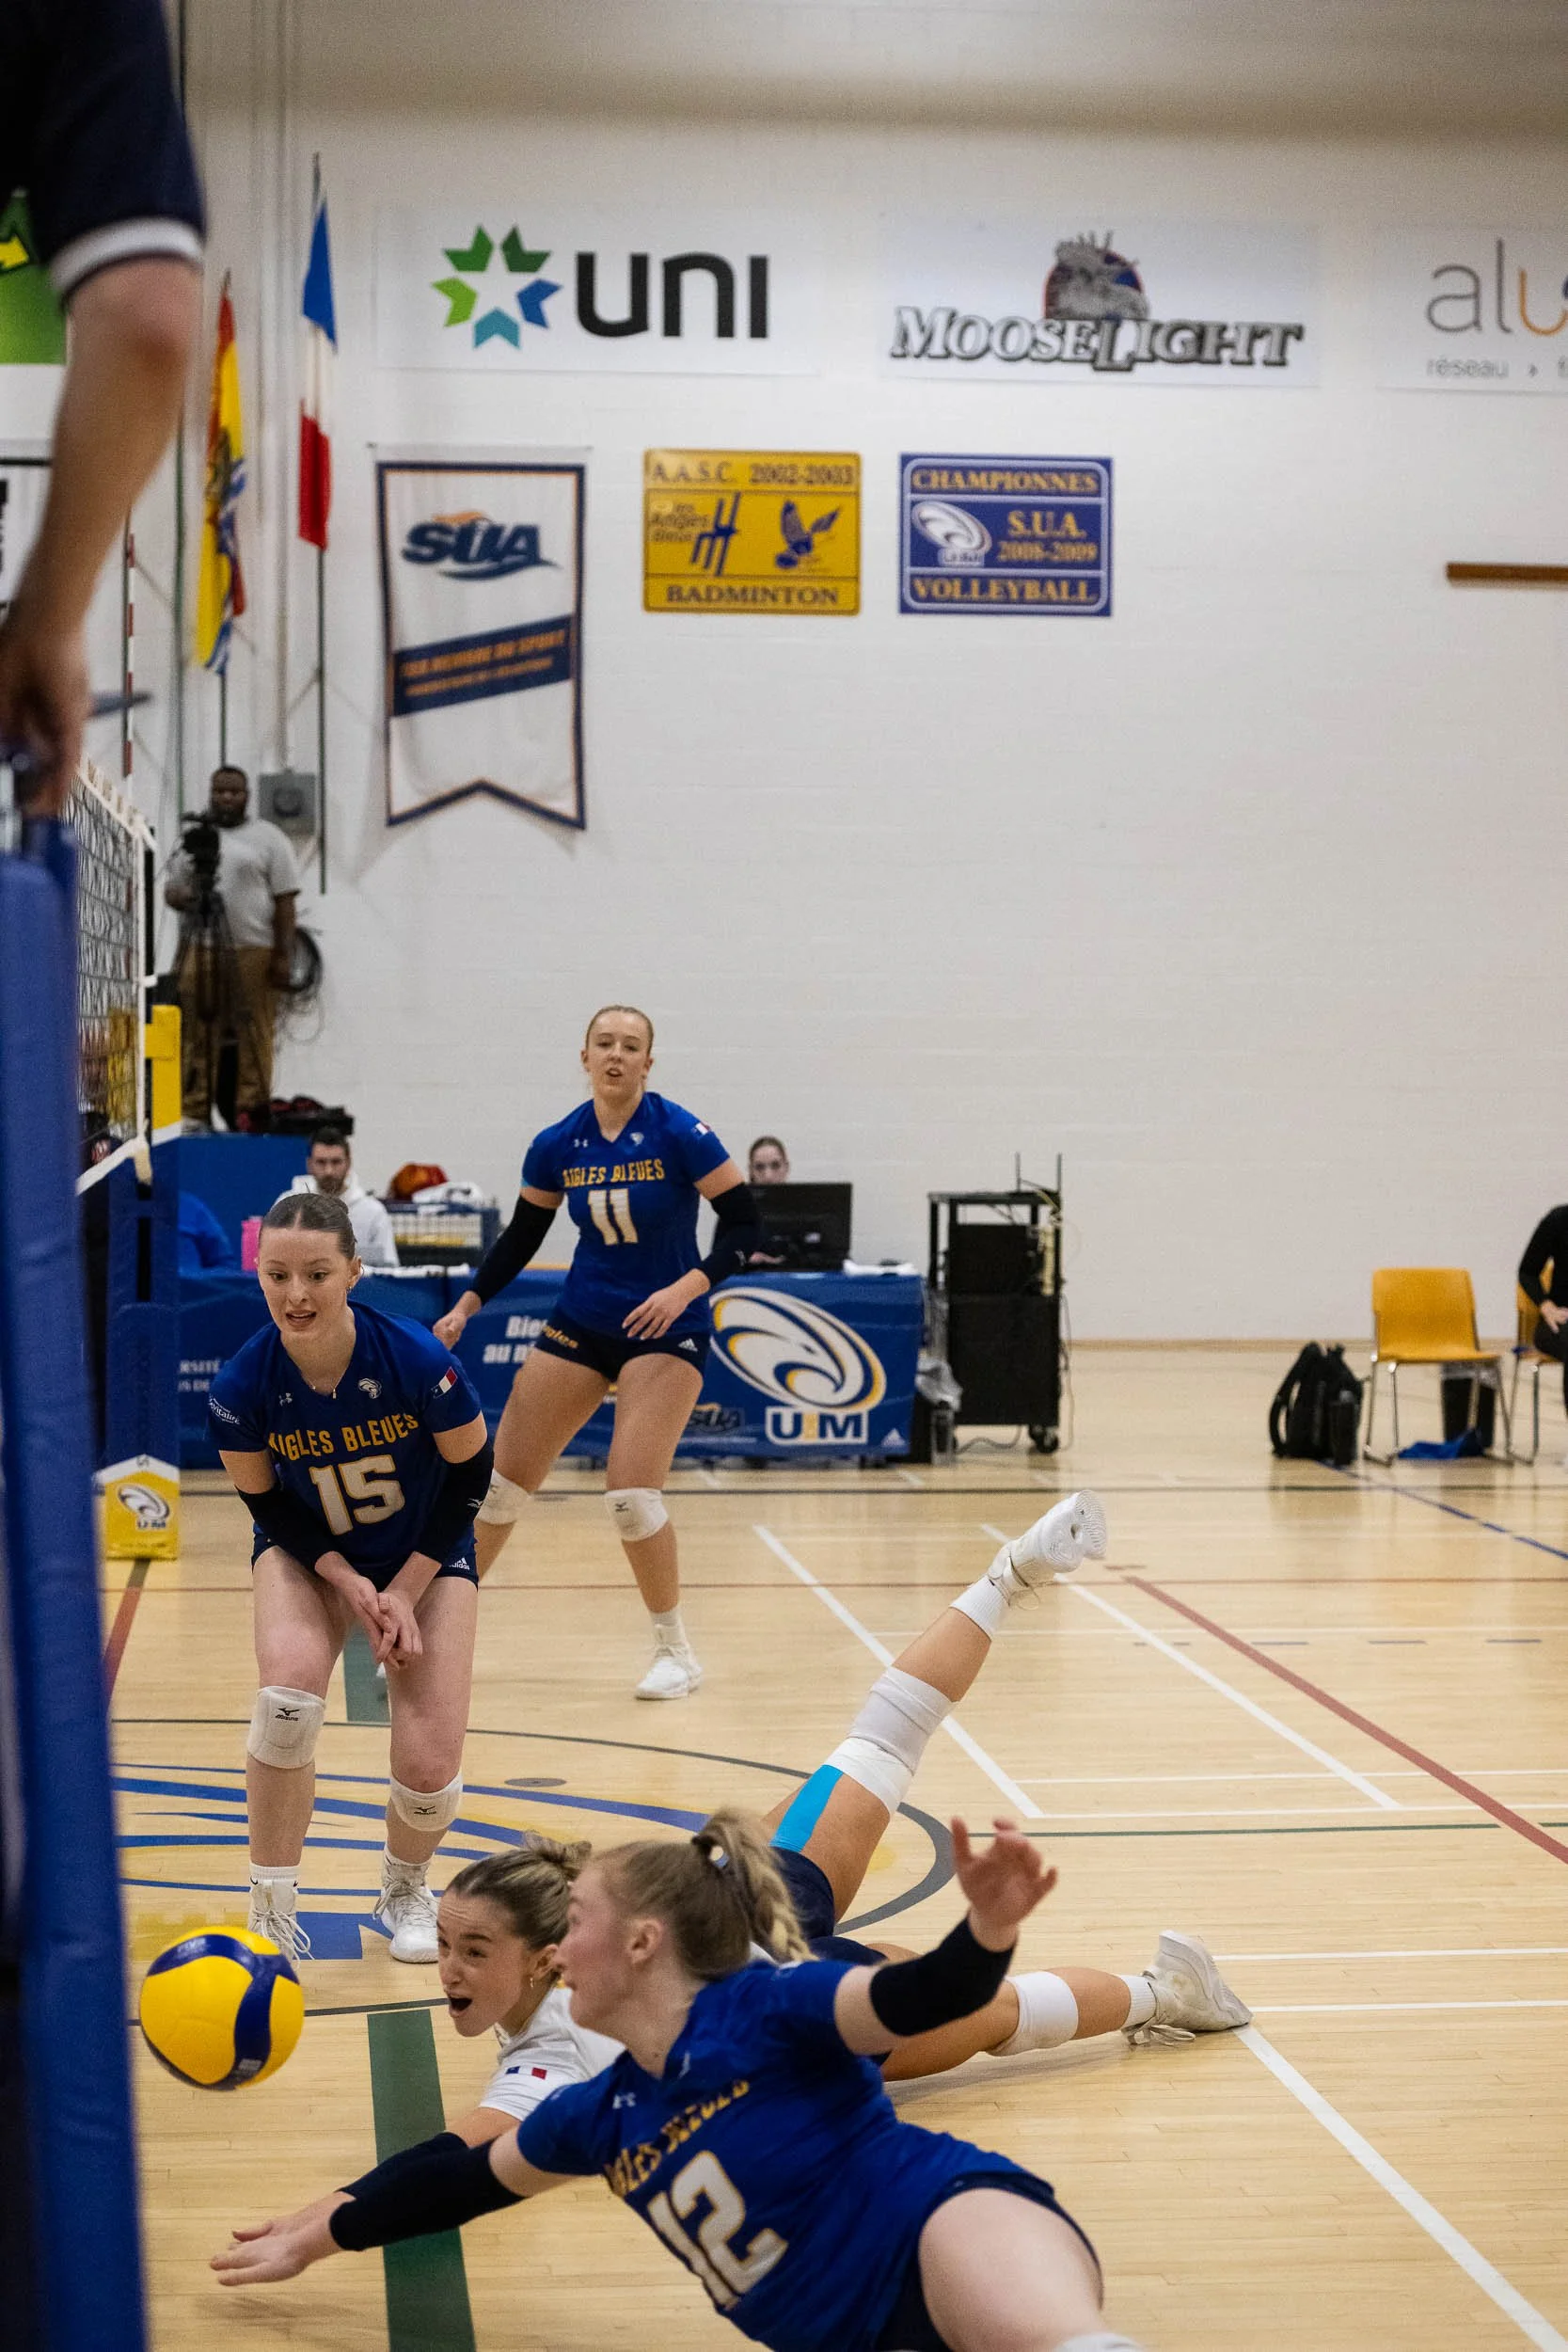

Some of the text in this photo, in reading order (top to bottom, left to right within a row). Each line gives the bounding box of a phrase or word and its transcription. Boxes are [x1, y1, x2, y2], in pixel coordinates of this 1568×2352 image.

[911, 469, 1099, 493] CHAMPIONNES
[666, 585, 839, 605] BADMINTON
[911, 578, 1098, 602] VOLLEYBALL
[610, 1158, 665, 1183] BLEUES
[587, 1188, 639, 1246] 11
[341, 1413, 420, 1452] BLEUES
[309, 1454, 405, 1536] 15
[647, 2150, 789, 2311] 12
